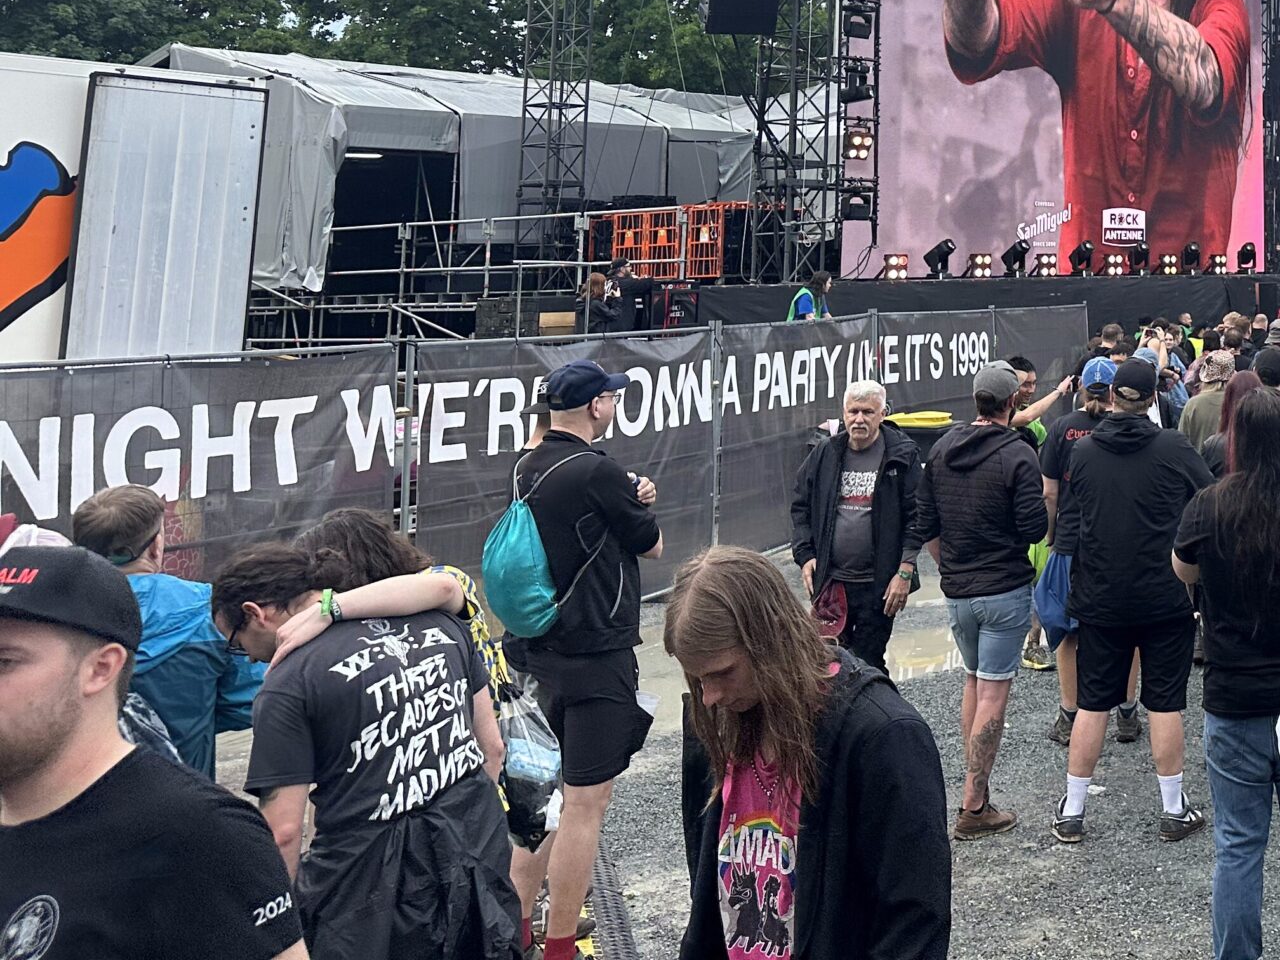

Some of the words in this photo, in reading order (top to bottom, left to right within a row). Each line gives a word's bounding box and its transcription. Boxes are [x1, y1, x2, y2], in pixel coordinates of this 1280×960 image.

[1104, 230, 1143, 240] ANTENNE
[752, 344, 843, 413] PARTY
[905, 332, 944, 382] IT'S
[949, 330, 989, 377] 1999
[366, 652, 448, 714] THREE
[368, 738, 485, 821] MADNESS
[386, 711, 471, 785] METAL
[253, 892, 293, 927] 2024
